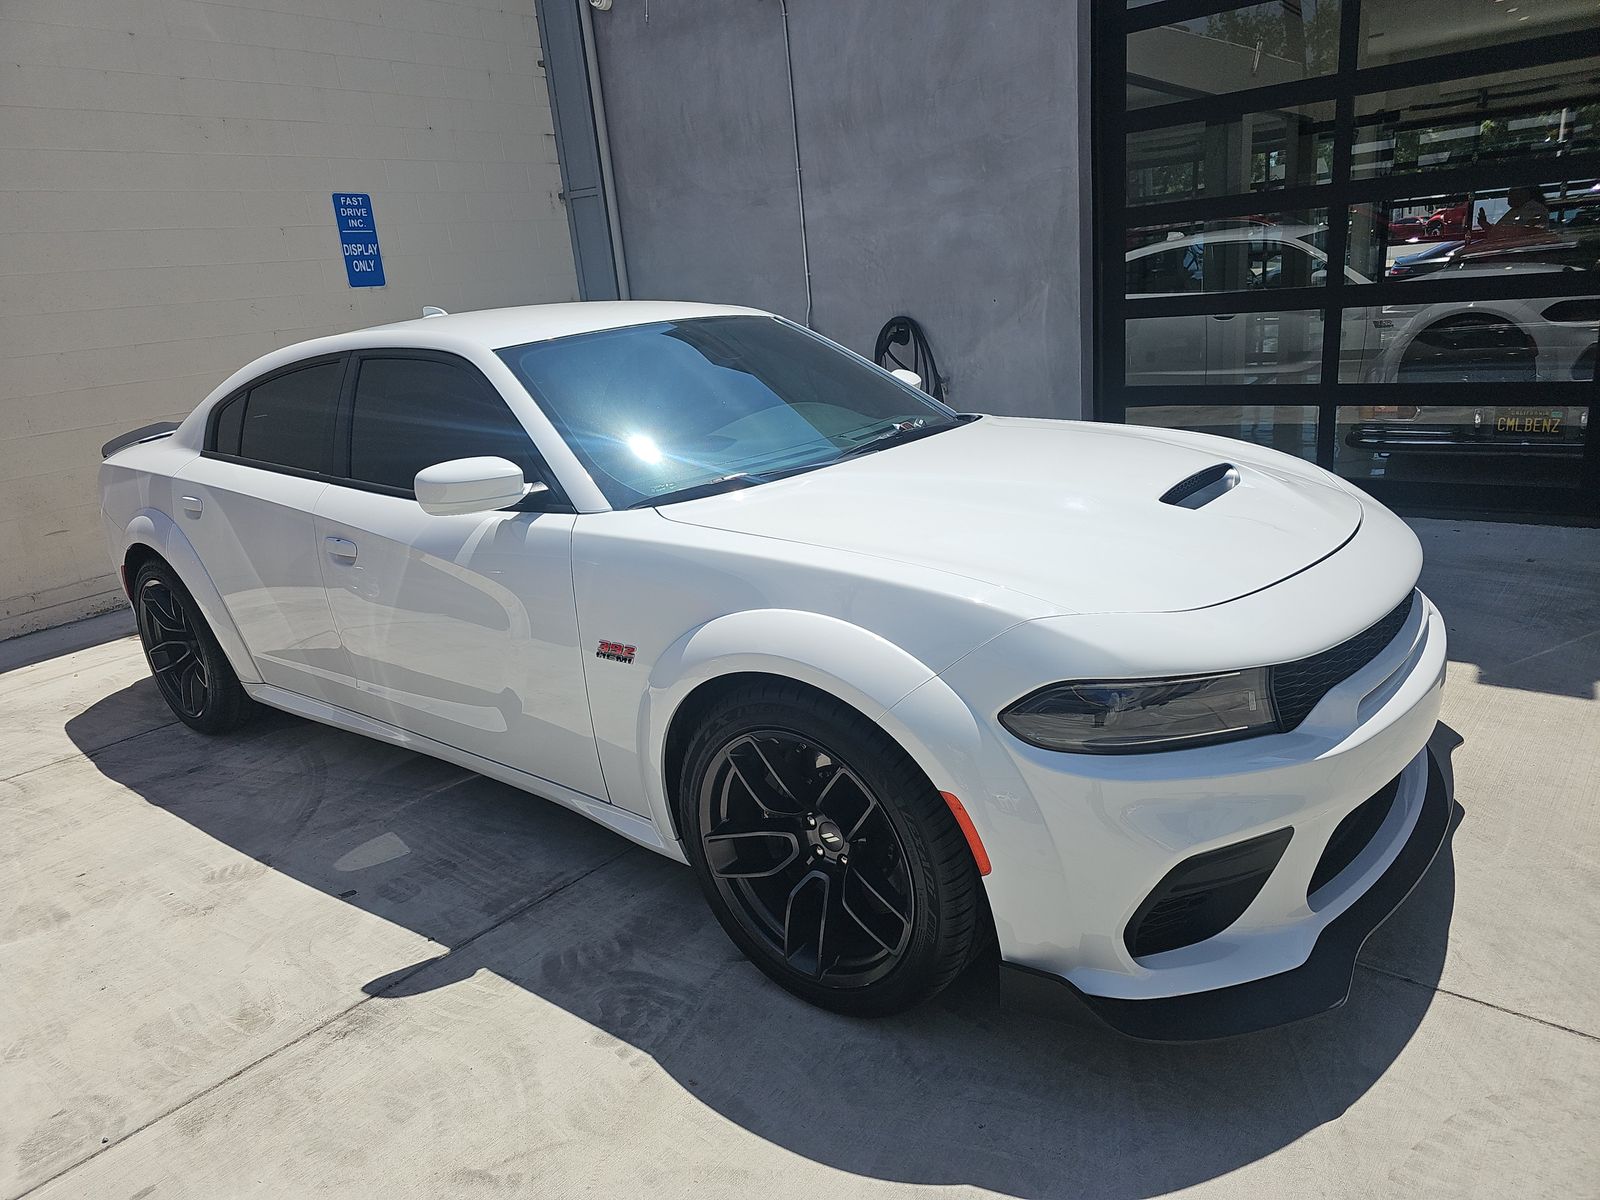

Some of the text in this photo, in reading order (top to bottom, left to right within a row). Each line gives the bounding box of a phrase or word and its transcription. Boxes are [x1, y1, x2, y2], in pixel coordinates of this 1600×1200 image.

[340, 197, 363, 206] FAST
[340, 208, 368, 217] DRIVE
[348, 219, 367, 228] INC.
[343, 243, 378, 256] DISPLAY
[352, 260, 375, 272] ONLY
[1497, 417, 1561, 433] CMLBENZ
